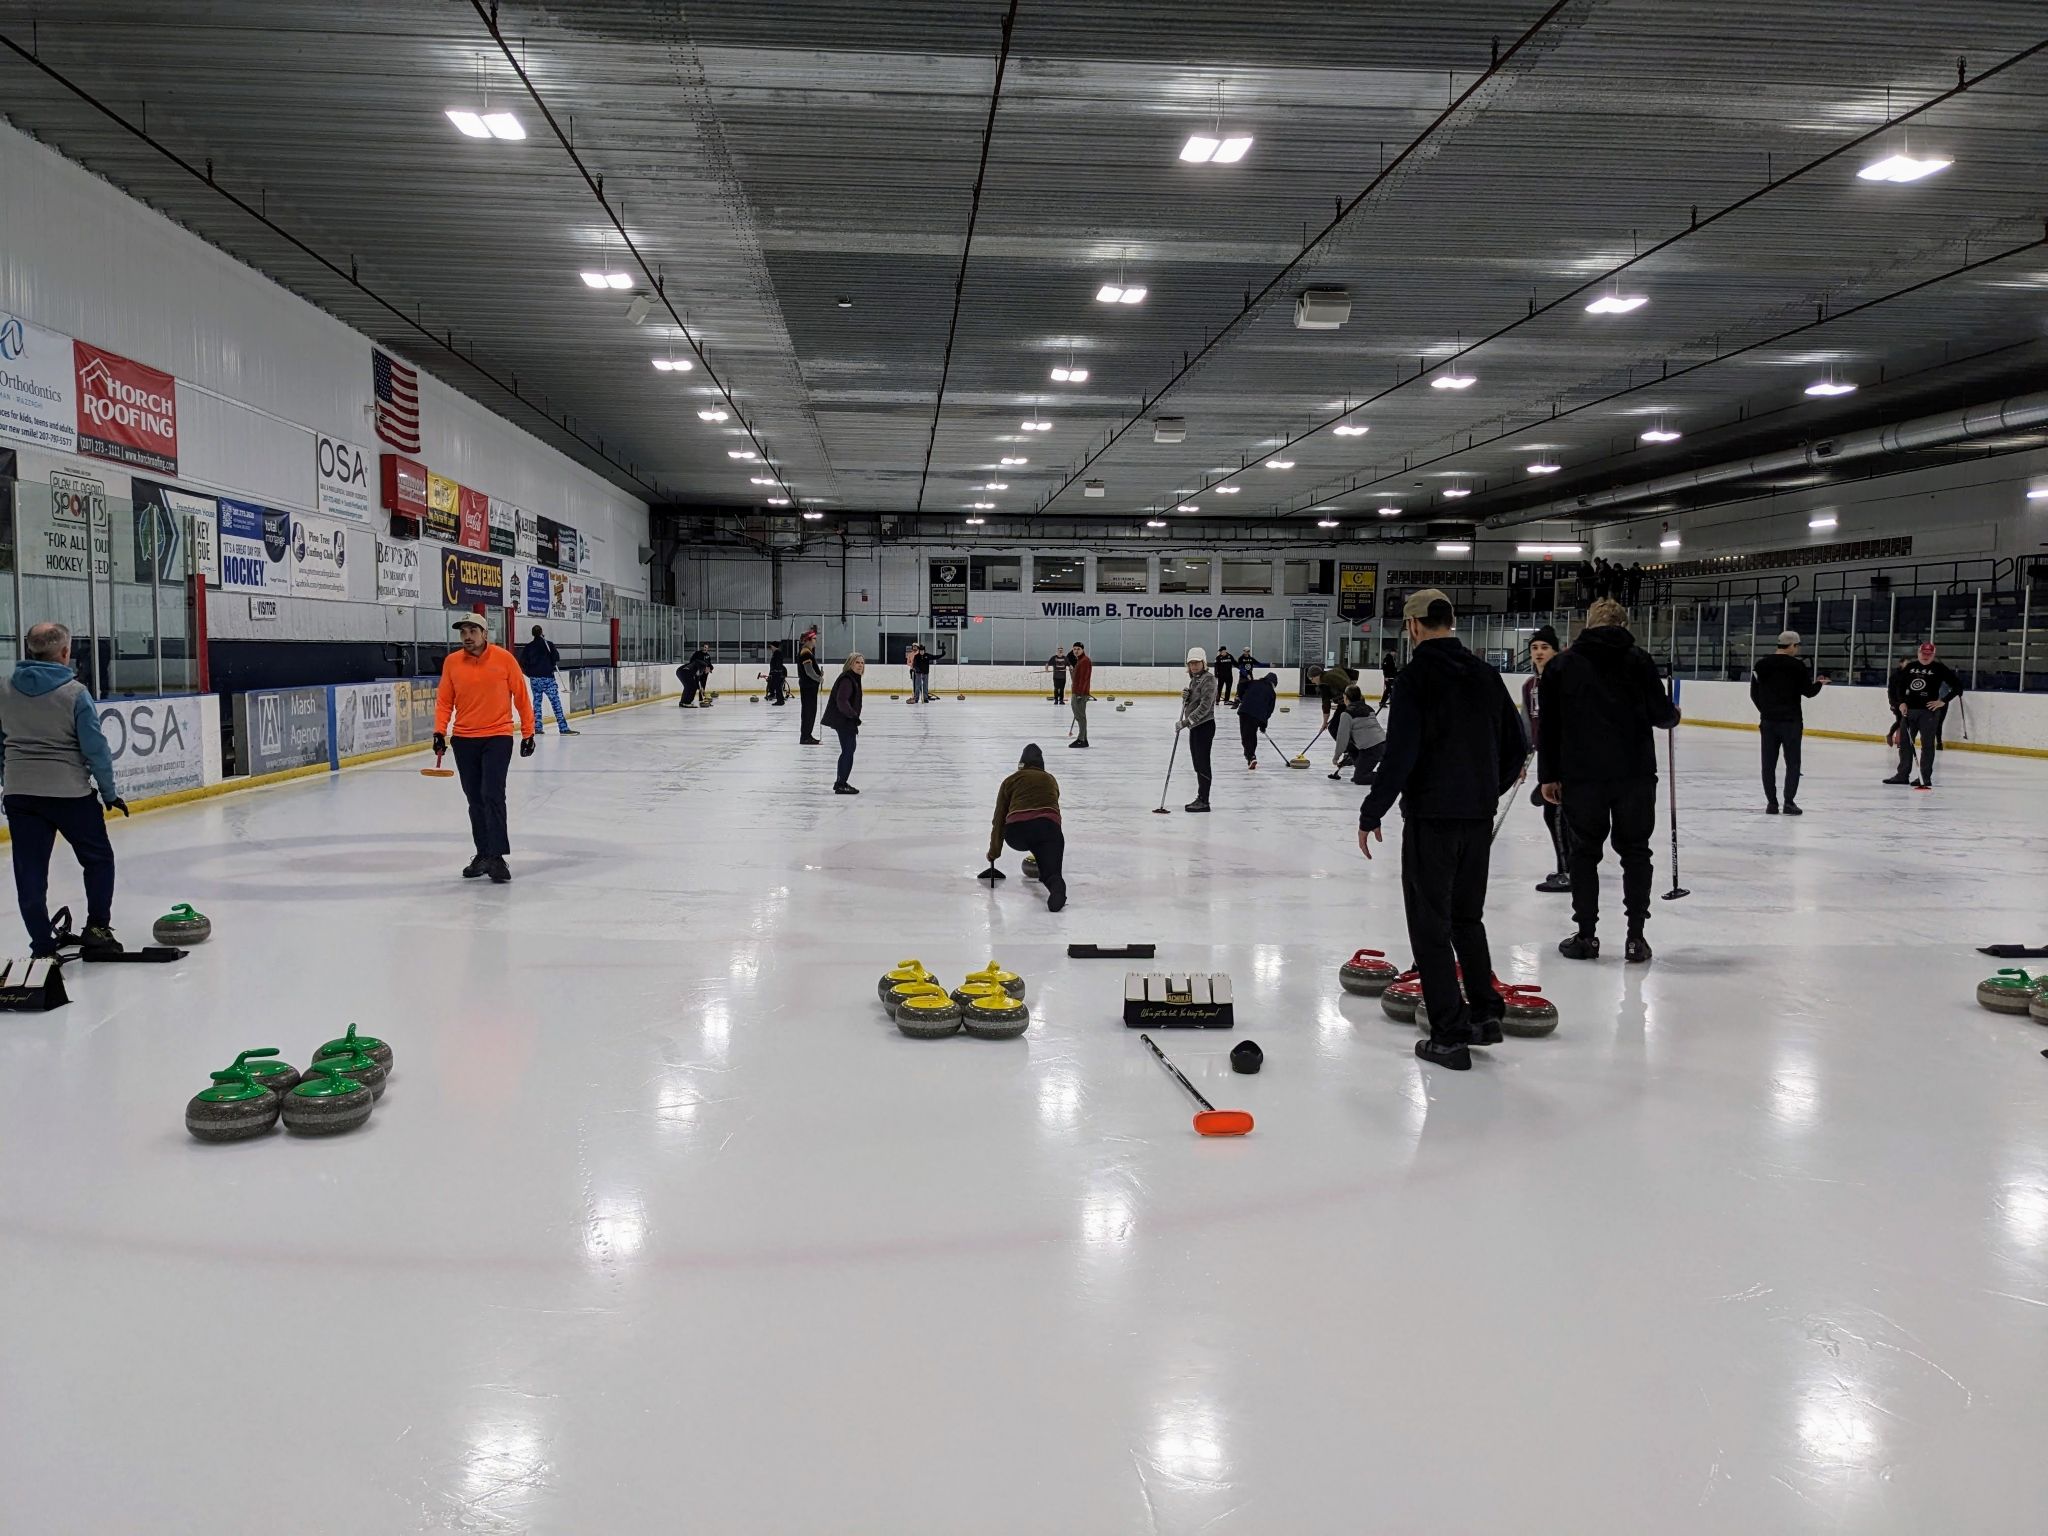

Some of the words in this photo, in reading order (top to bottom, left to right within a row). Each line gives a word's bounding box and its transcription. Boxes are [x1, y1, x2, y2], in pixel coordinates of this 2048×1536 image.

[0, 370, 62, 402] Orthodontics
[107, 378, 173, 416] HORCH
[83, 393, 174, 438] ROOFING
[9, 425, 20, 434] new
[319, 438, 367, 488] OSA
[308, 531, 319, 543] Pine
[319, 533, 330, 545] Tree
[46, 554, 84, 573] HOCKEY
[460, 560, 502, 588] CHEVERUS
[257, 600, 277, 616] VISITOR
[1042, 602, 1100, 618] William
[1105, 603, 1122, 618] B.
[1126, 603, 1184, 618] Troubh
[1188, 603, 1213, 618] Ice
[1217, 604, 1265, 619] Arena
[291, 692, 316, 716] Marsh
[362, 693, 391, 720] WOLF
[100, 705, 184, 760] OSA
[290, 724, 321, 750] Agency
